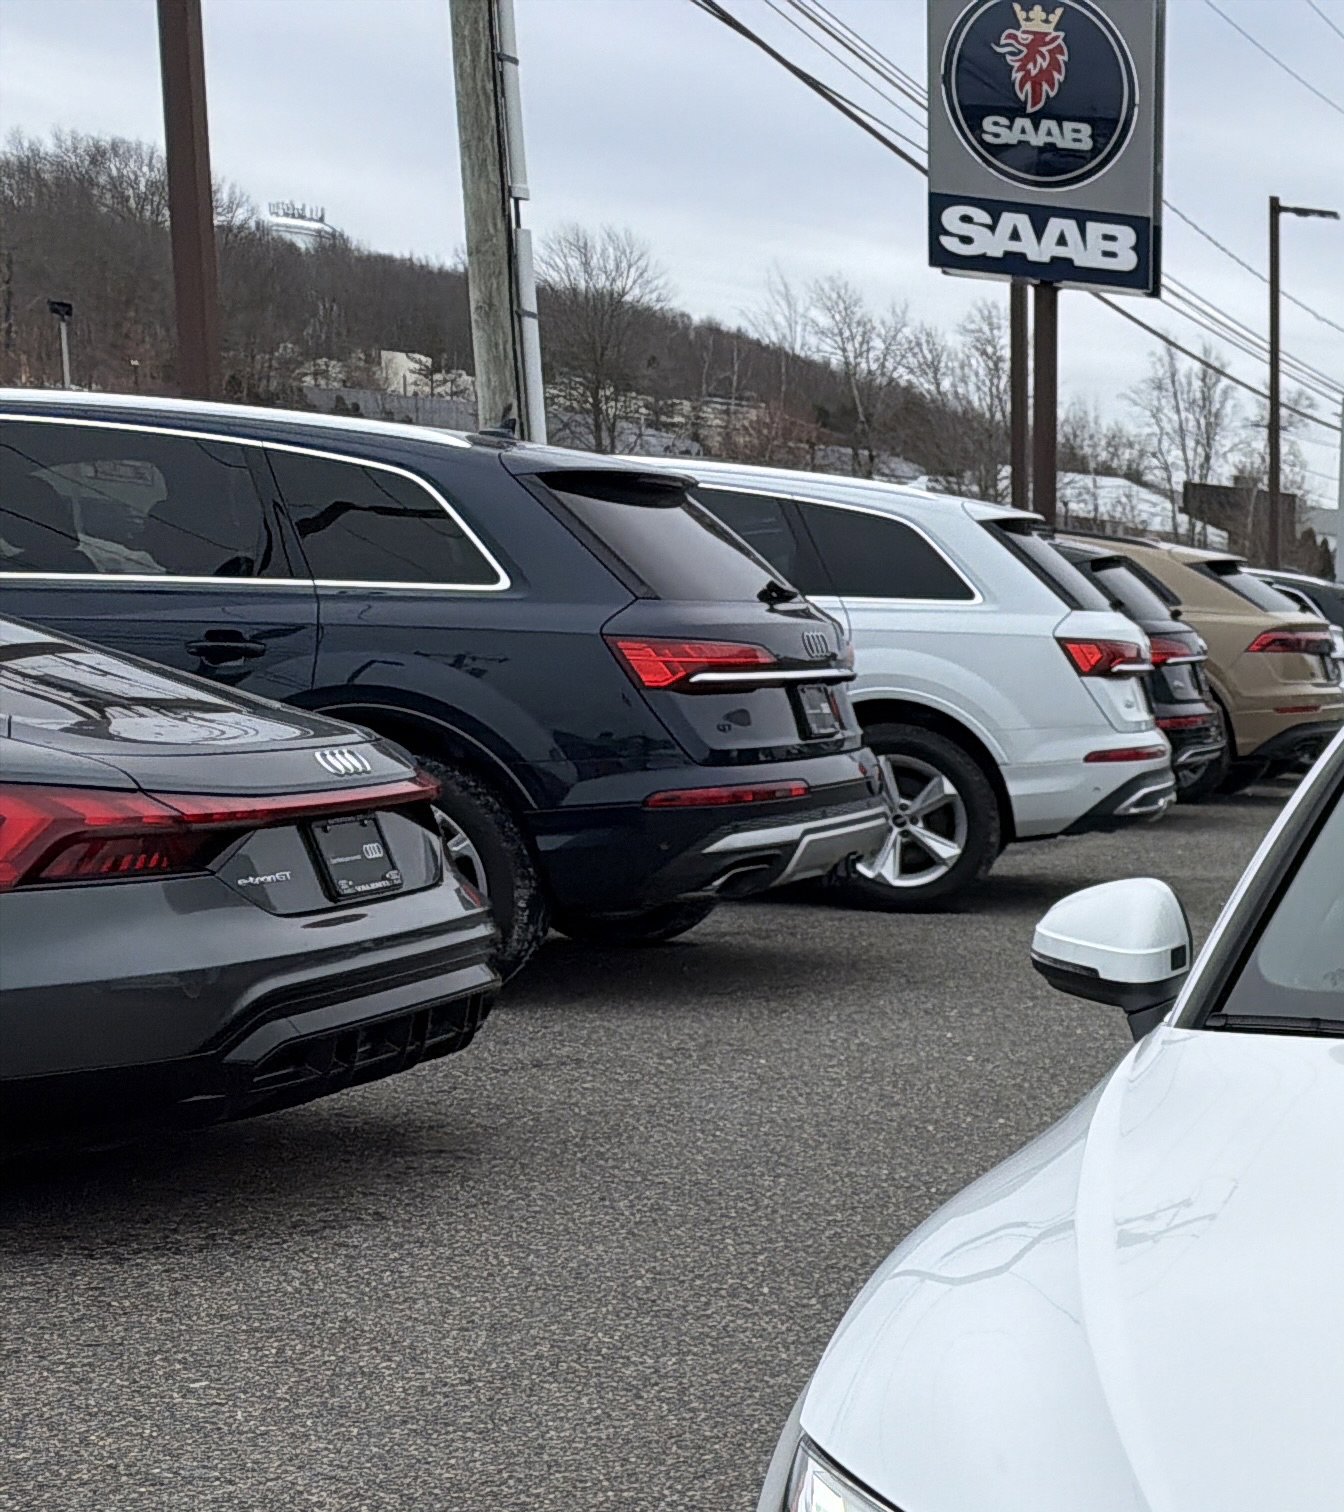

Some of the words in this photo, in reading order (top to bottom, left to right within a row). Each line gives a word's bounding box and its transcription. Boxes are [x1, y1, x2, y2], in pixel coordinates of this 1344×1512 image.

[981, 115, 1093, 151] SAAB
[938, 205, 1139, 272] SAAB
[275, 870, 292, 881] GT
